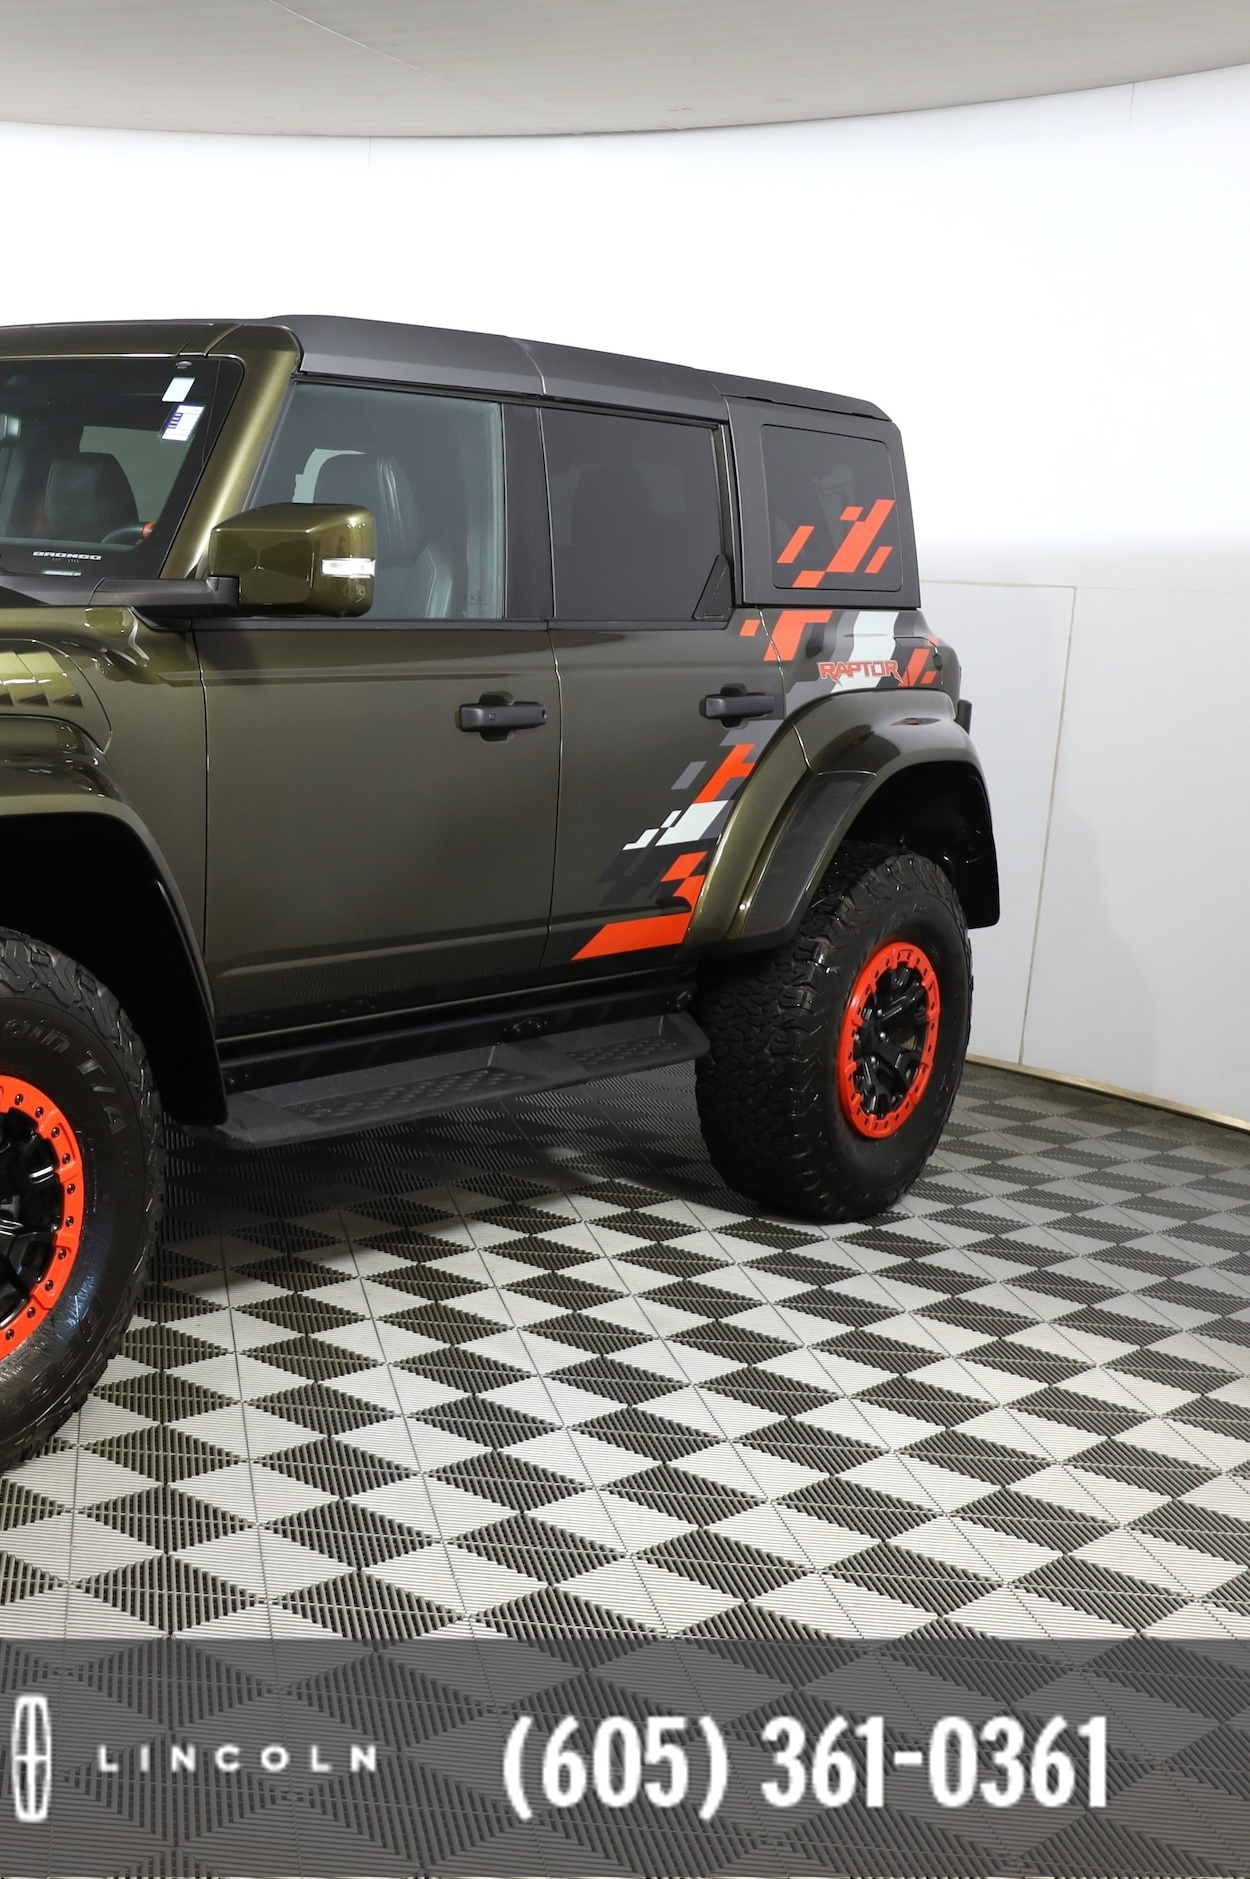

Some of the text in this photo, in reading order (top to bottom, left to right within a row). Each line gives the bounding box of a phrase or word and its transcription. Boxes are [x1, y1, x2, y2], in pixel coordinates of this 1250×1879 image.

[32, 551, 102, 560] BRONCO
[817, 660, 904, 685] RAPTOR
[76, 1047, 127, 1135] T/A
